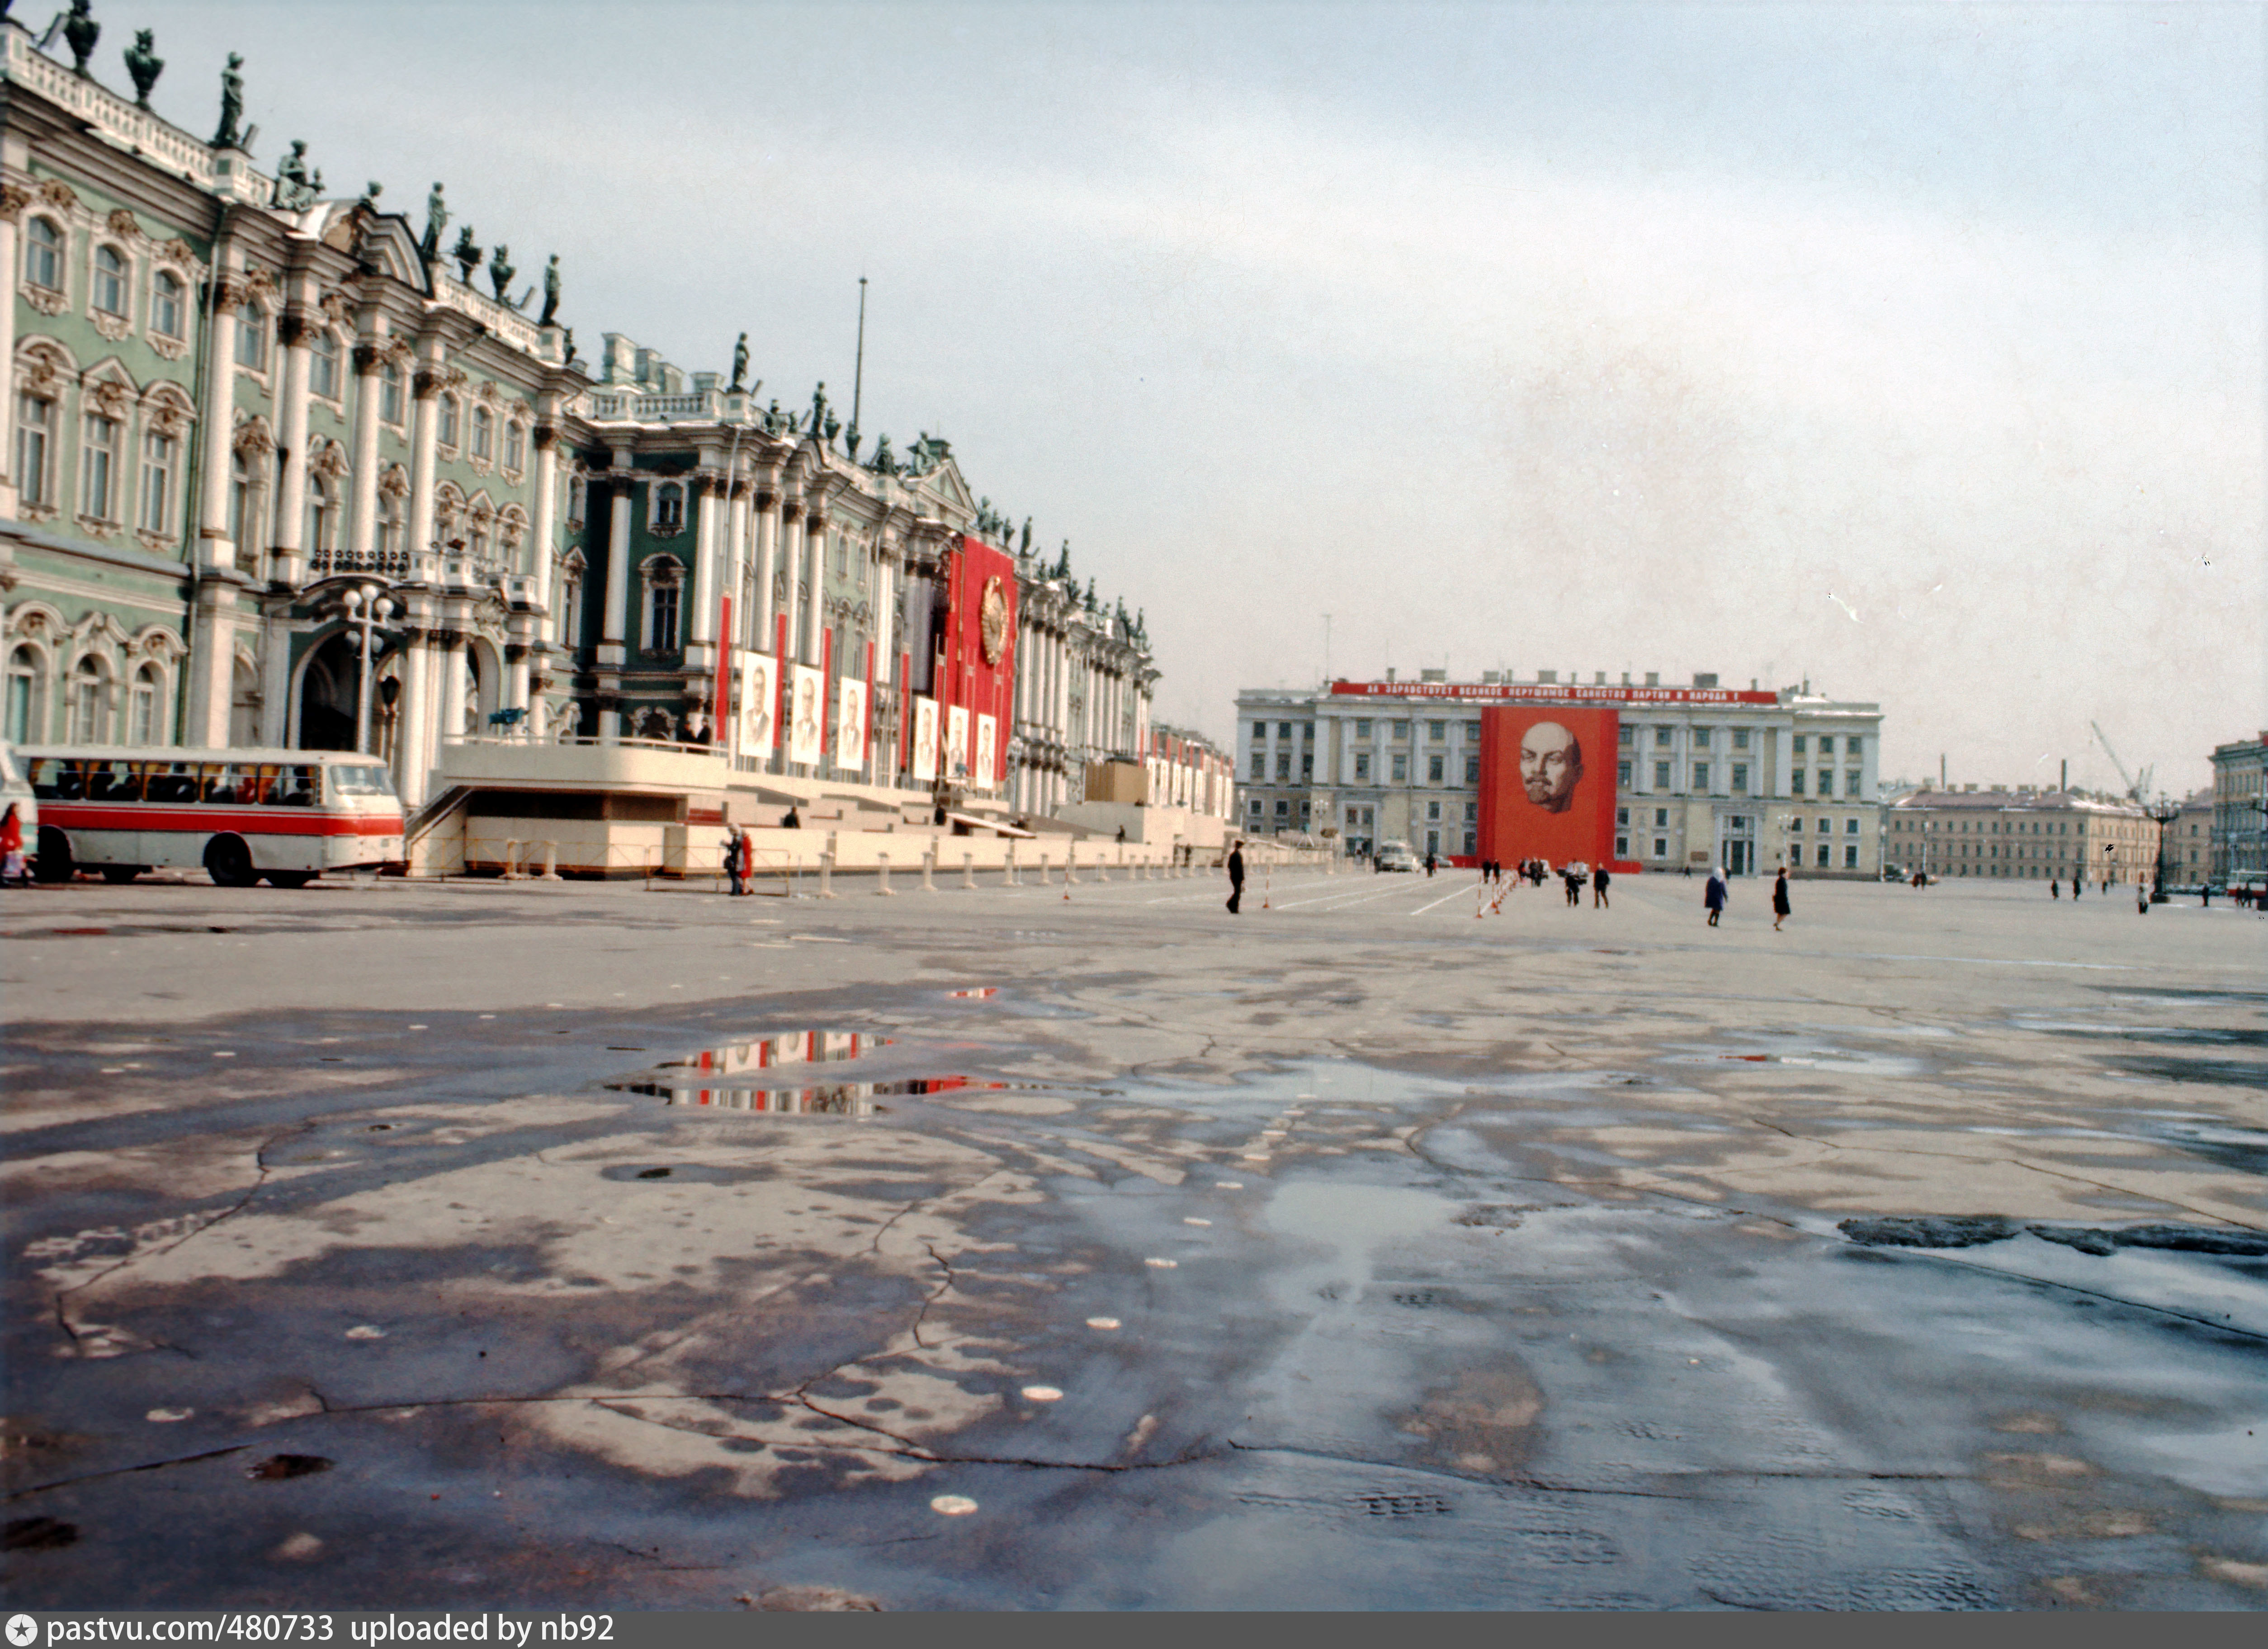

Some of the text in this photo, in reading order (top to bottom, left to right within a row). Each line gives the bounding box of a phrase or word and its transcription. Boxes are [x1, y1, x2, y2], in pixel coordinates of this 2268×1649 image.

[1368, 685, 1378, 693] ДА
[1386, 685, 1452, 695] ЗДРАВСТВУЕТ
[1459, 686, 1502, 696] ВЕЛИКОЕ
[1509, 688, 1569, 697] НЕРУШИМОЕ
[1576, 689, 1625, 698] ЕДИНСТВО
[1633, 690, 1670, 699] ПАРТИИ
